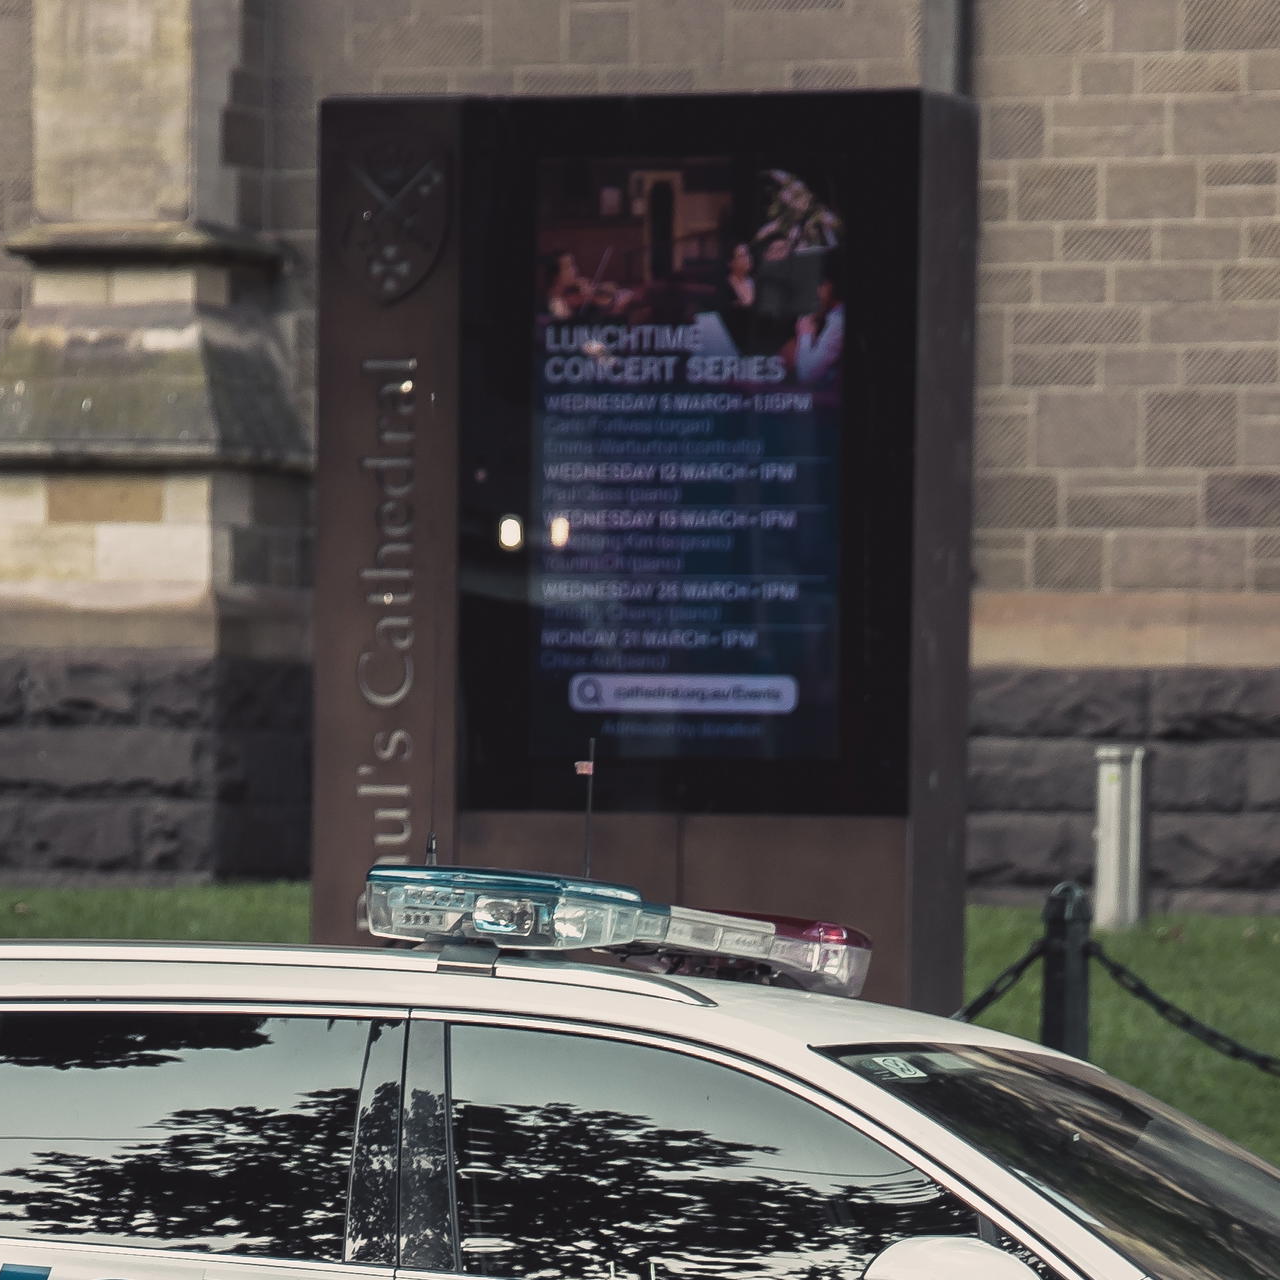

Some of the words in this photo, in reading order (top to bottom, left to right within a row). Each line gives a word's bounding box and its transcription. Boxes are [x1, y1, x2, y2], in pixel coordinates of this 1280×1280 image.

[545, 323, 703, 352] LUNCHTIME
[544, 355, 678, 384] CONCERT
[686, 355, 786, 383] SERIES
[357, 357, 418, 708] Cathedral
